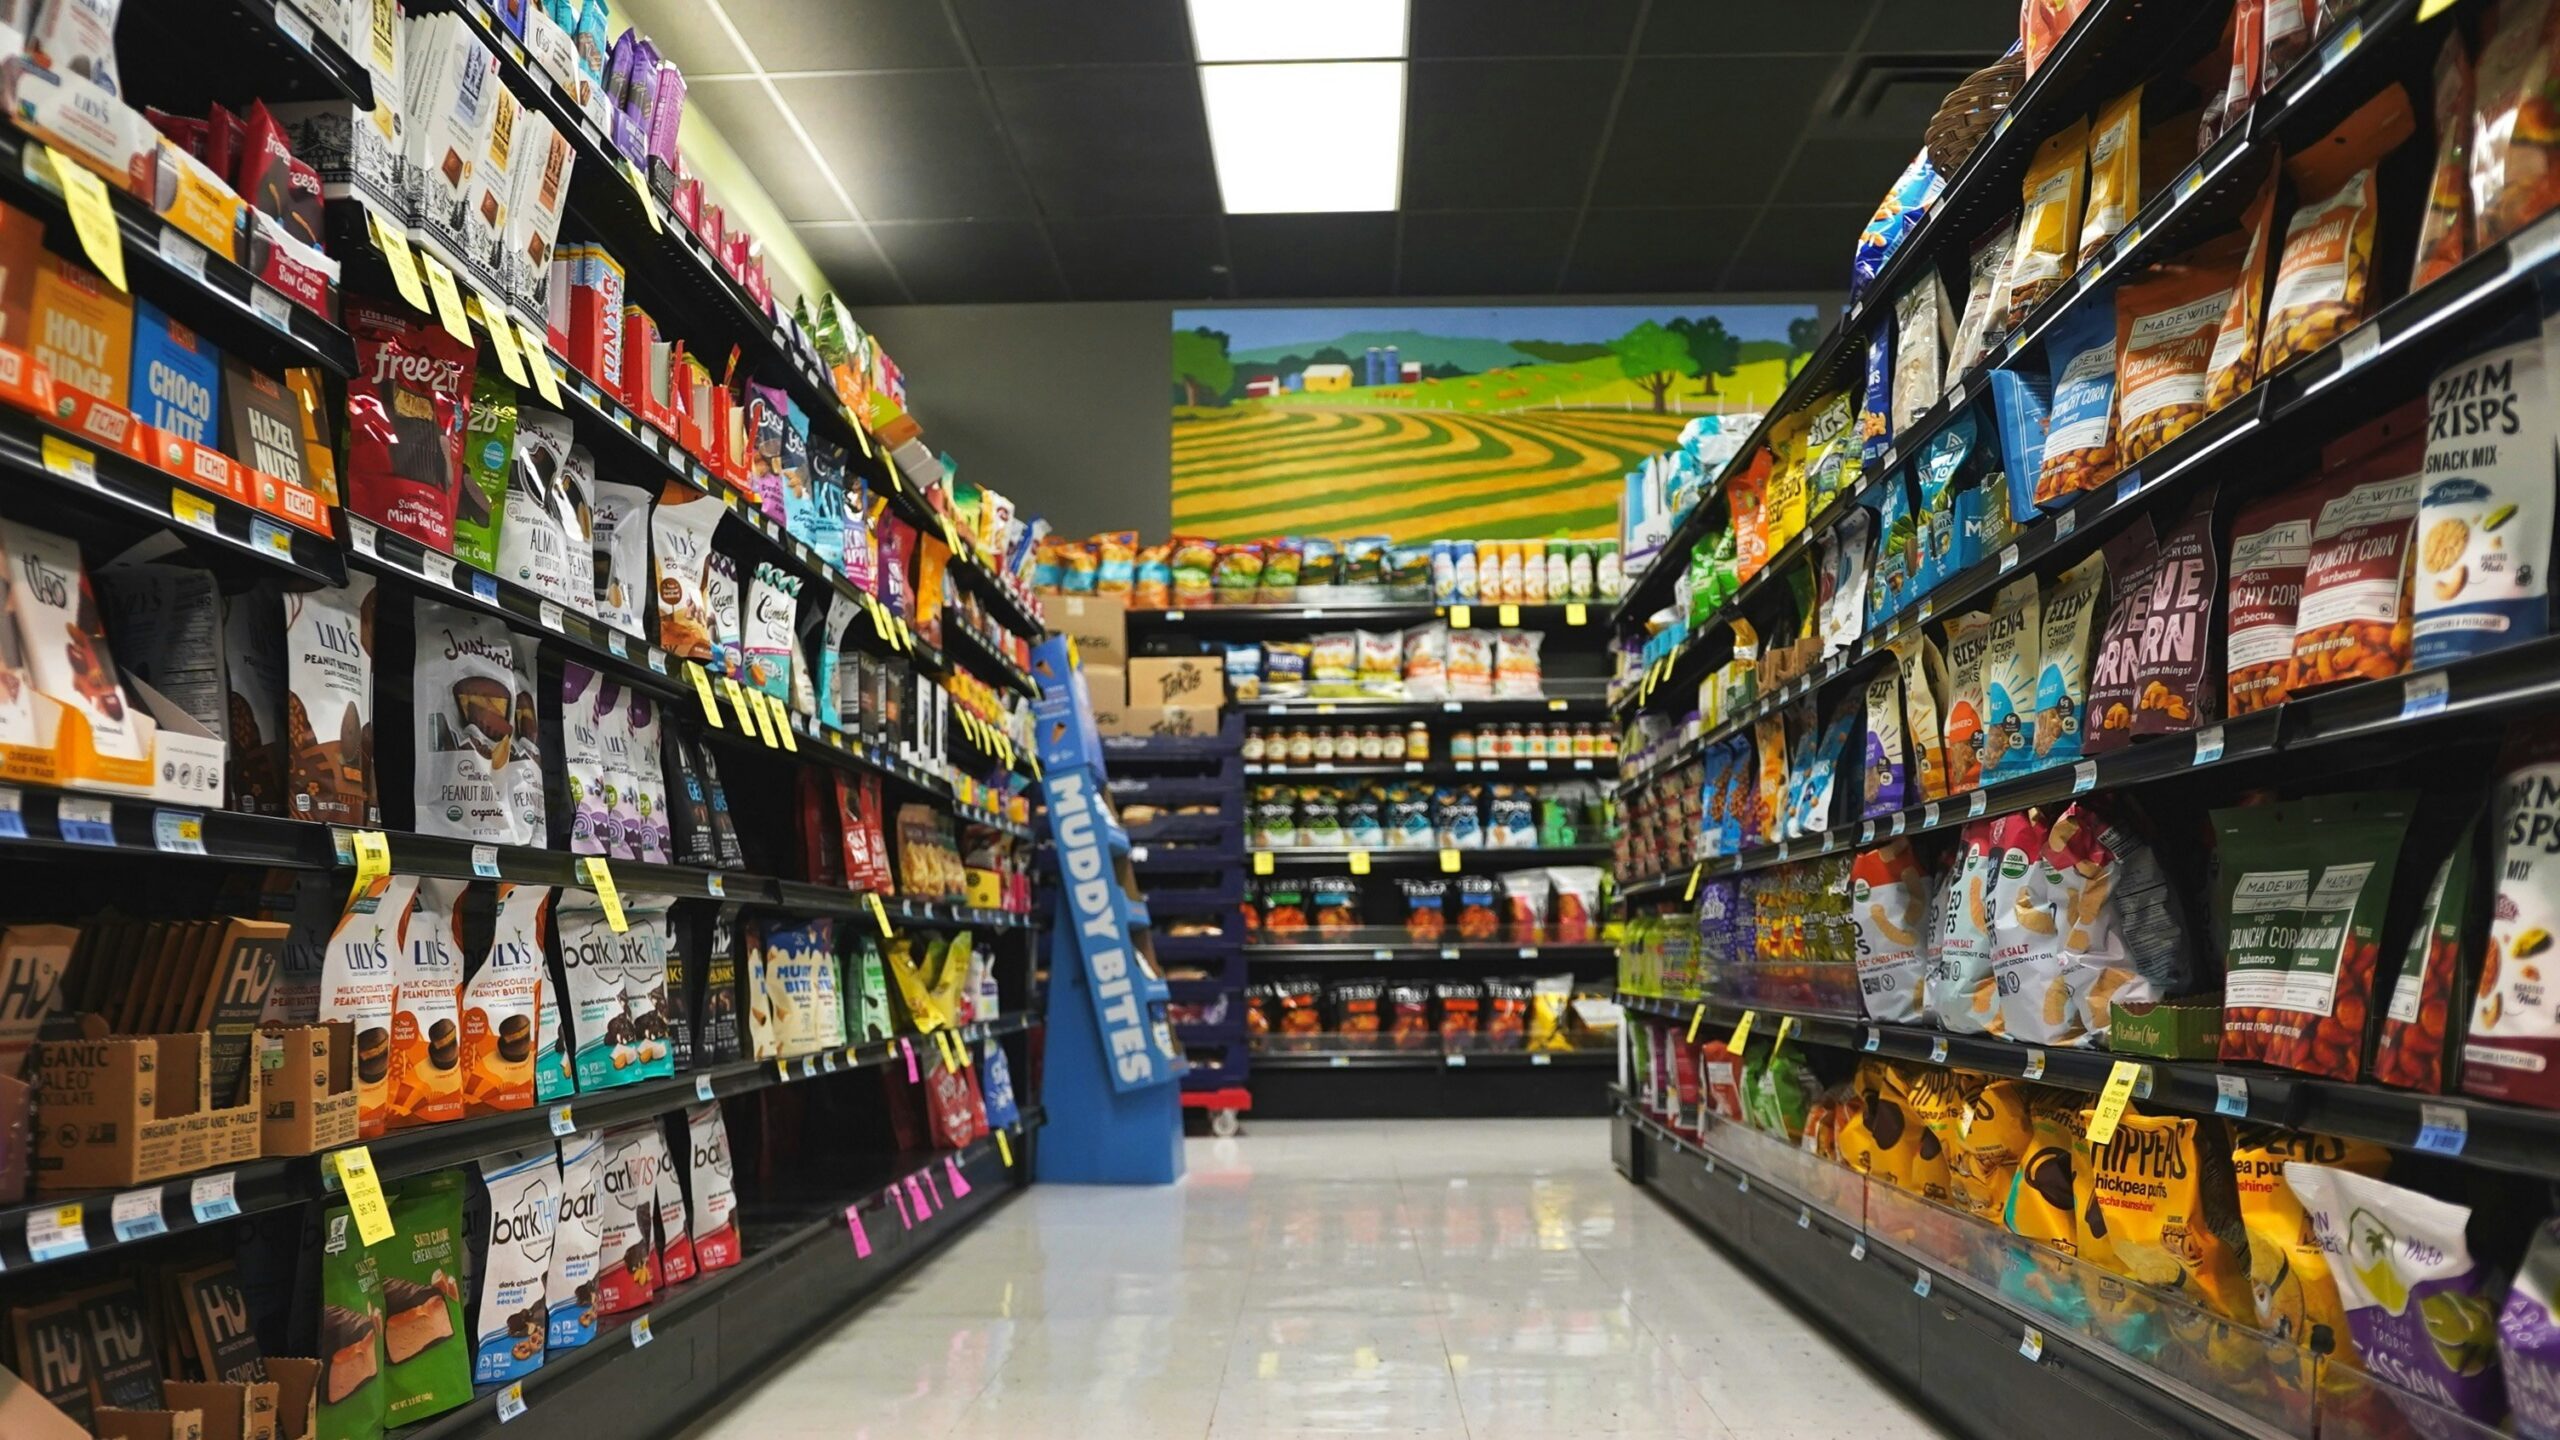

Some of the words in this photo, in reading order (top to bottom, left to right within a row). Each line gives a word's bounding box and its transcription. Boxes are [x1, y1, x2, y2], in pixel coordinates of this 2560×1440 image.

[44, 307, 109, 369] HOLY
[148, 359, 211, 422] CHOCO
[2430, 357, 2515, 412] PARM
[247, 406, 300, 461] HAZEL
[196, 452, 227, 477] TCHO
[2425, 448, 2469, 475] SNACK
[2471, 444, 2498, 469] MIX
[286, 491, 315, 517] TCHO
[2306, 541, 2359, 577] CRUNCHY
[2358, 533, 2398, 562] CORN
[2318, 567, 2362, 587] barbecue
[2233, 610, 2277, 628] barbecue
[315, 620, 361, 659] LILY'S
[303, 653, 336, 668] PEANUT
[1160, 667, 1202, 702] Takis
[6, 764, 29, 777] FAIR
[29, 765, 56, 779] TRADE
[441, 785, 479, 801] PEANUT
[471, 807, 504, 823] organic
[1049, 773, 1120, 941] MUDDY
[1092, 949, 1152, 1086] BITES
[2230, 926, 2269, 951] CRUNCHY
[345, 941, 389, 970] LILY'S
[2006, 943, 2030, 958] SALT
[2238, 952, 2277, 965] habanero
[336, 985, 355, 995] MILK
[402, 979, 420, 989] MILK
[402, 989, 435, 999] PEANUT
[471, 988, 501, 998] PEANUT
[502, 986, 528, 996] BUTTER
[1338, 985, 1384, 1000] TERRA
[333, 996, 366, 1007] PEANUT
[2095, 1172, 2148, 1197] hickpea
[2406, 1234, 2445, 1267] PALEO
